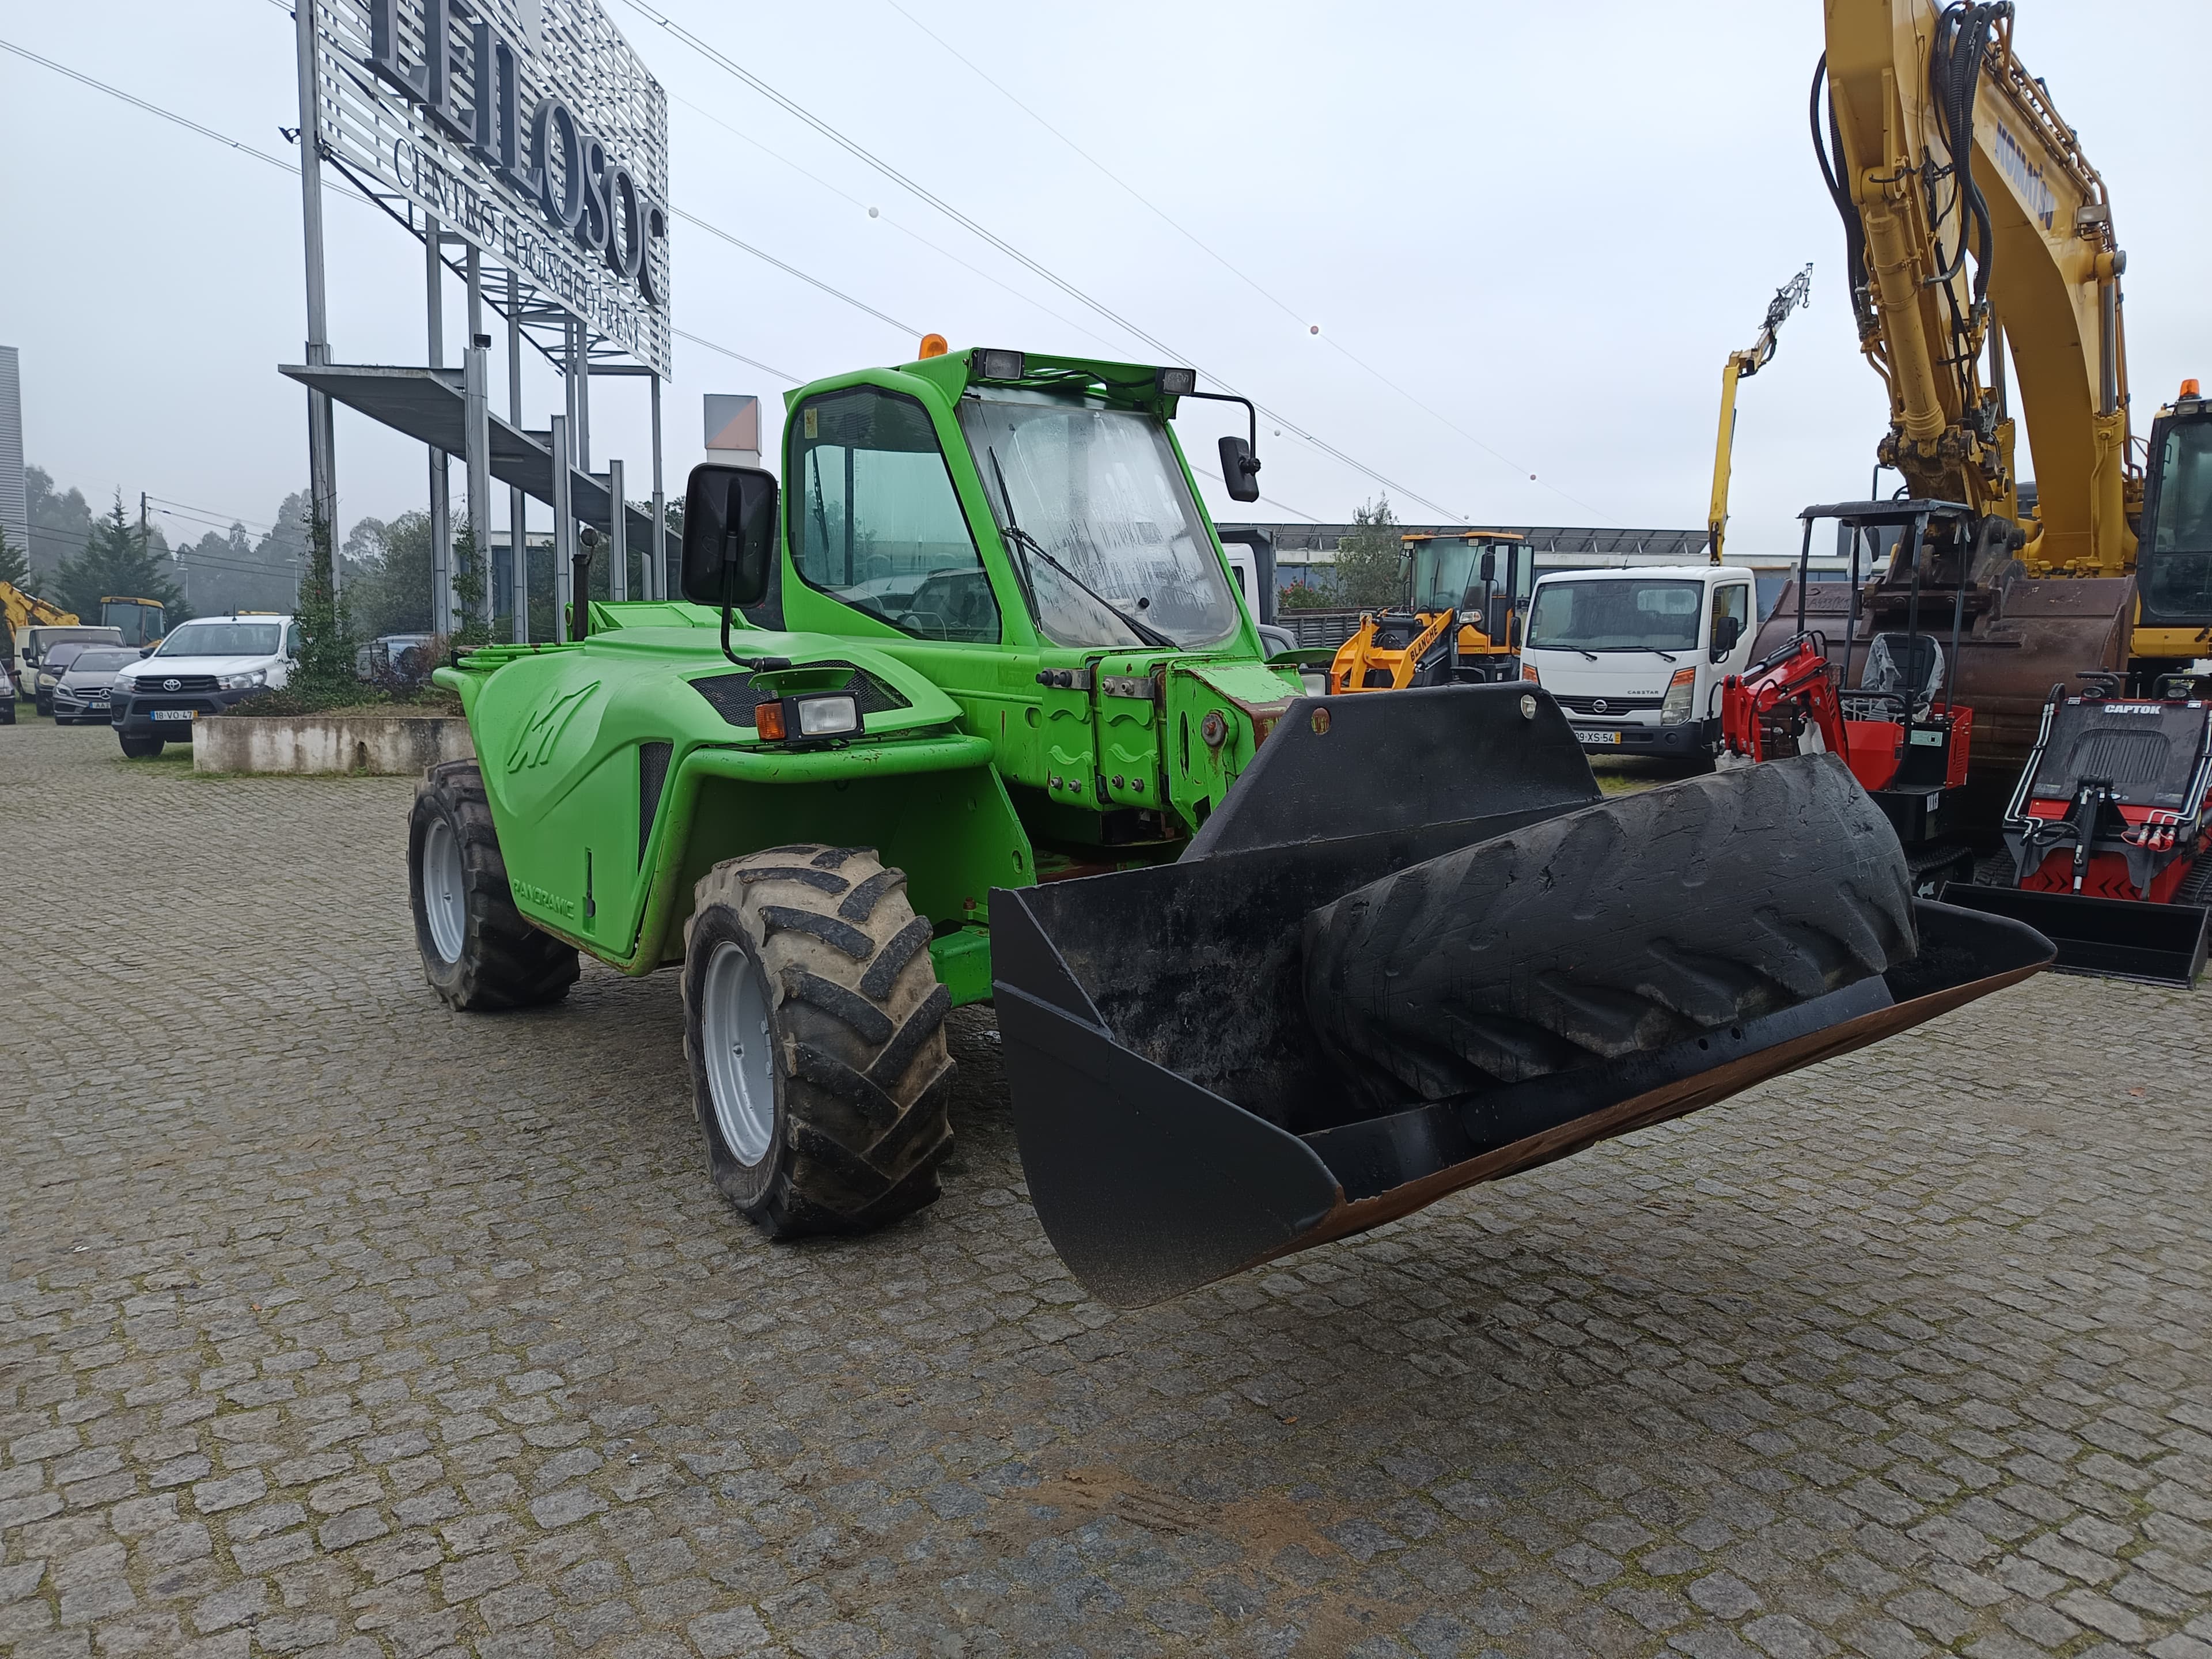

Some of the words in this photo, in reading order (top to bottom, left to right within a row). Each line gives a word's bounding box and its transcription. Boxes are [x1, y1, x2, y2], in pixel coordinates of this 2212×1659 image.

[394, 138, 495, 247] CENTRO
[1995, 116, 2055, 230] KOMATSU
[1410, 624, 1438, 662] BLANCHE
[156, 711, 192, 719] 18-VO-47
[2104, 704, 2161, 714] CAPTOK
[513, 878, 574, 921] PANORAMIC
